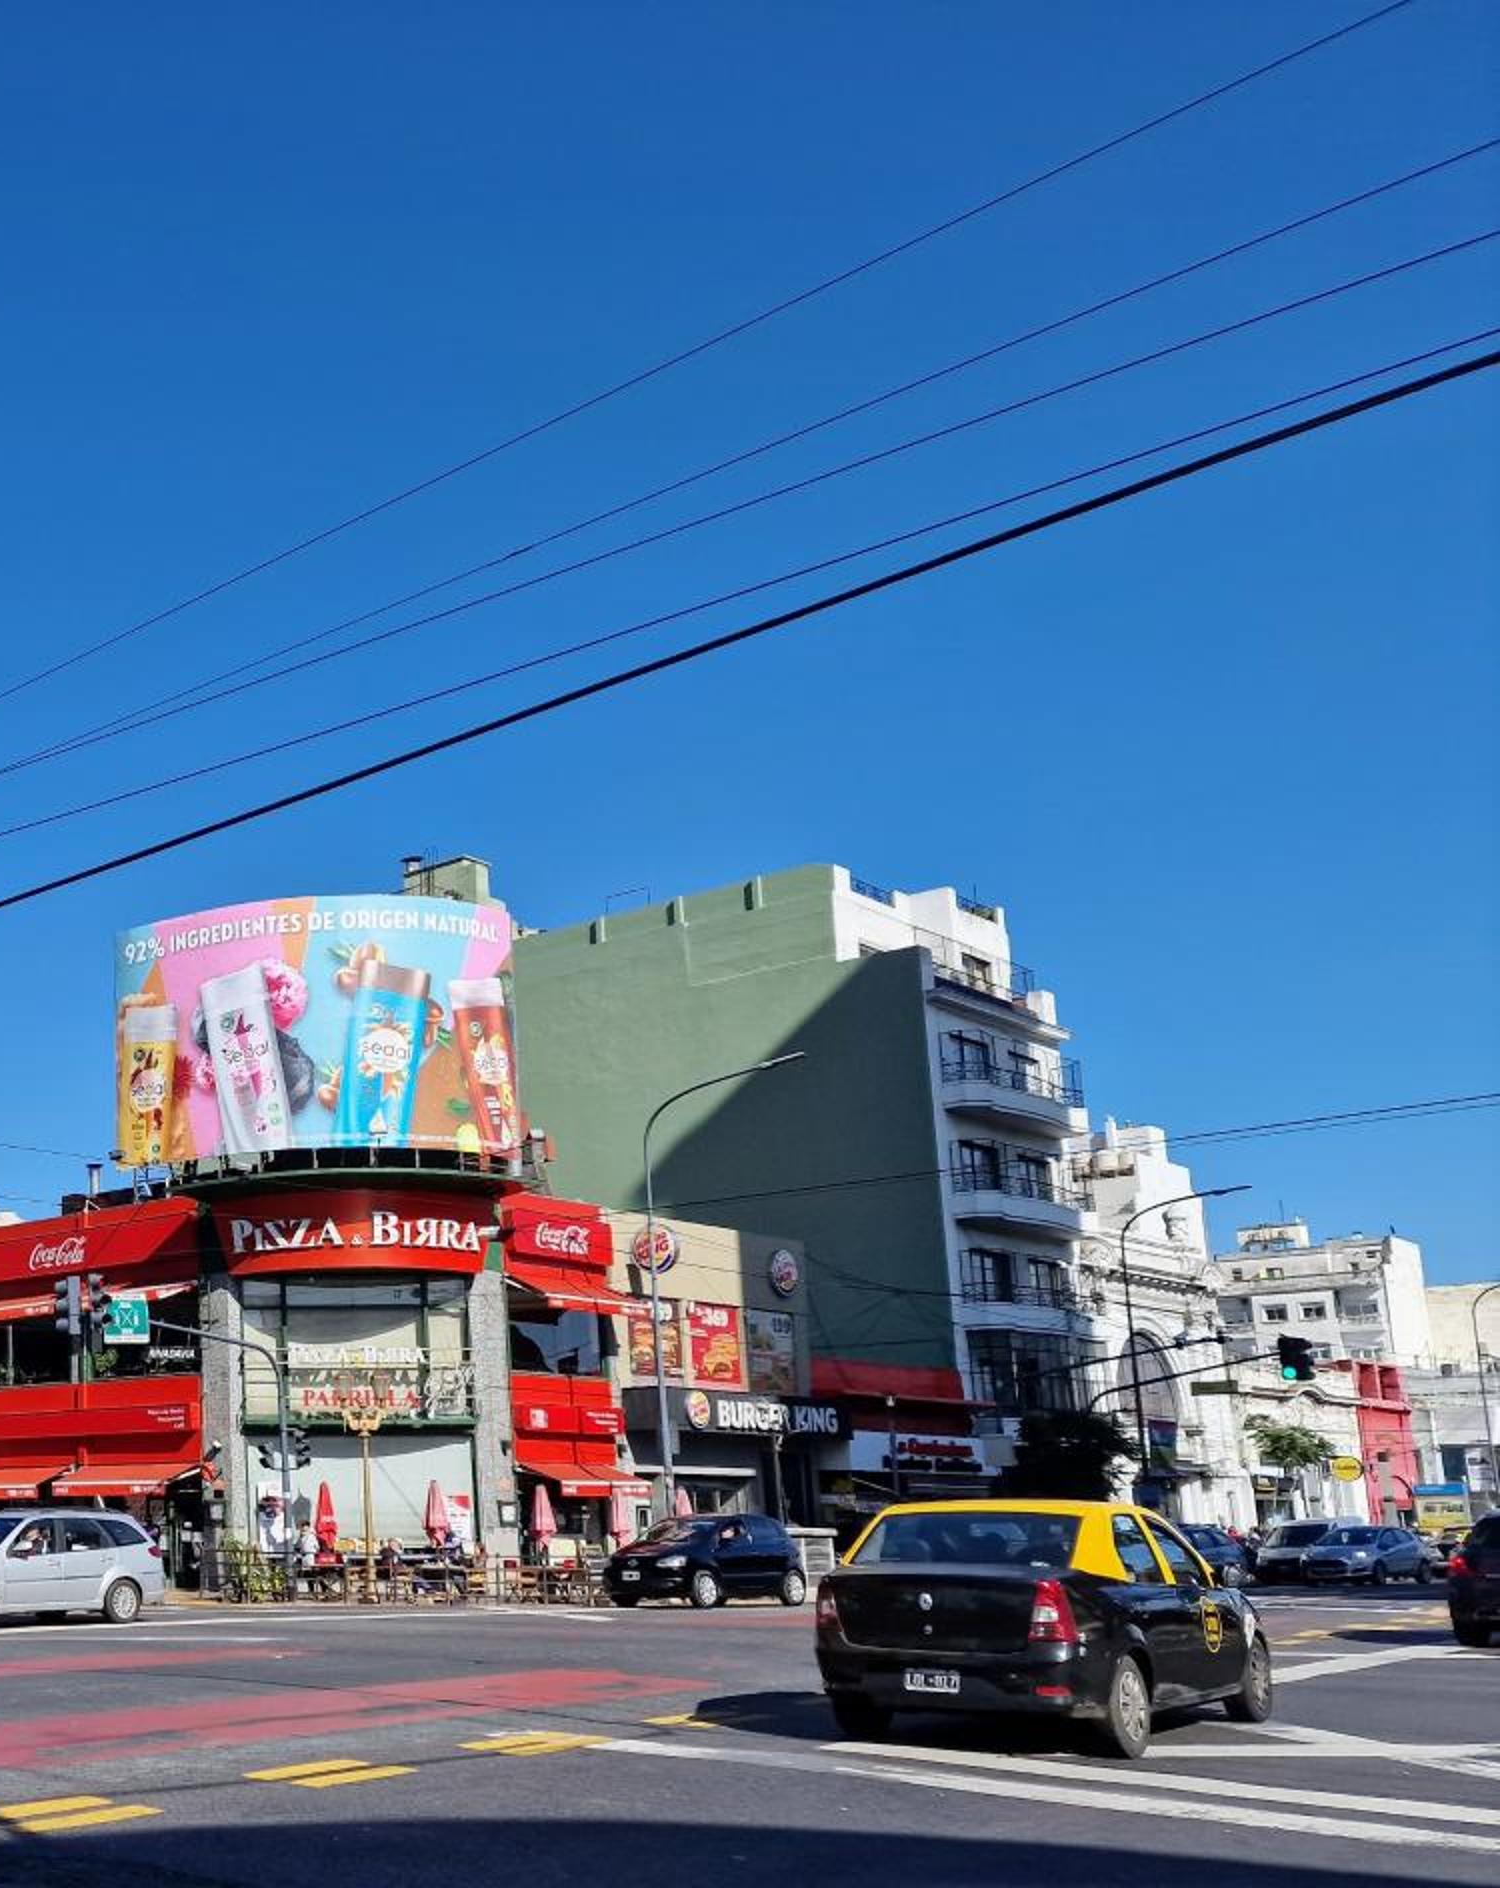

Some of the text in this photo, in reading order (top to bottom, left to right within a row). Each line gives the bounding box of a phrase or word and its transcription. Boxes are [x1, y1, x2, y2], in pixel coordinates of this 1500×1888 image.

[124, 909, 500, 965] 92% INGREDIENTES DE ORIGEN NATURAL
[29, 1235, 87, 1272] Coca-Cola
[717, 1399, 791, 1431] BURGER
[794, 1405, 839, 1434] KING
